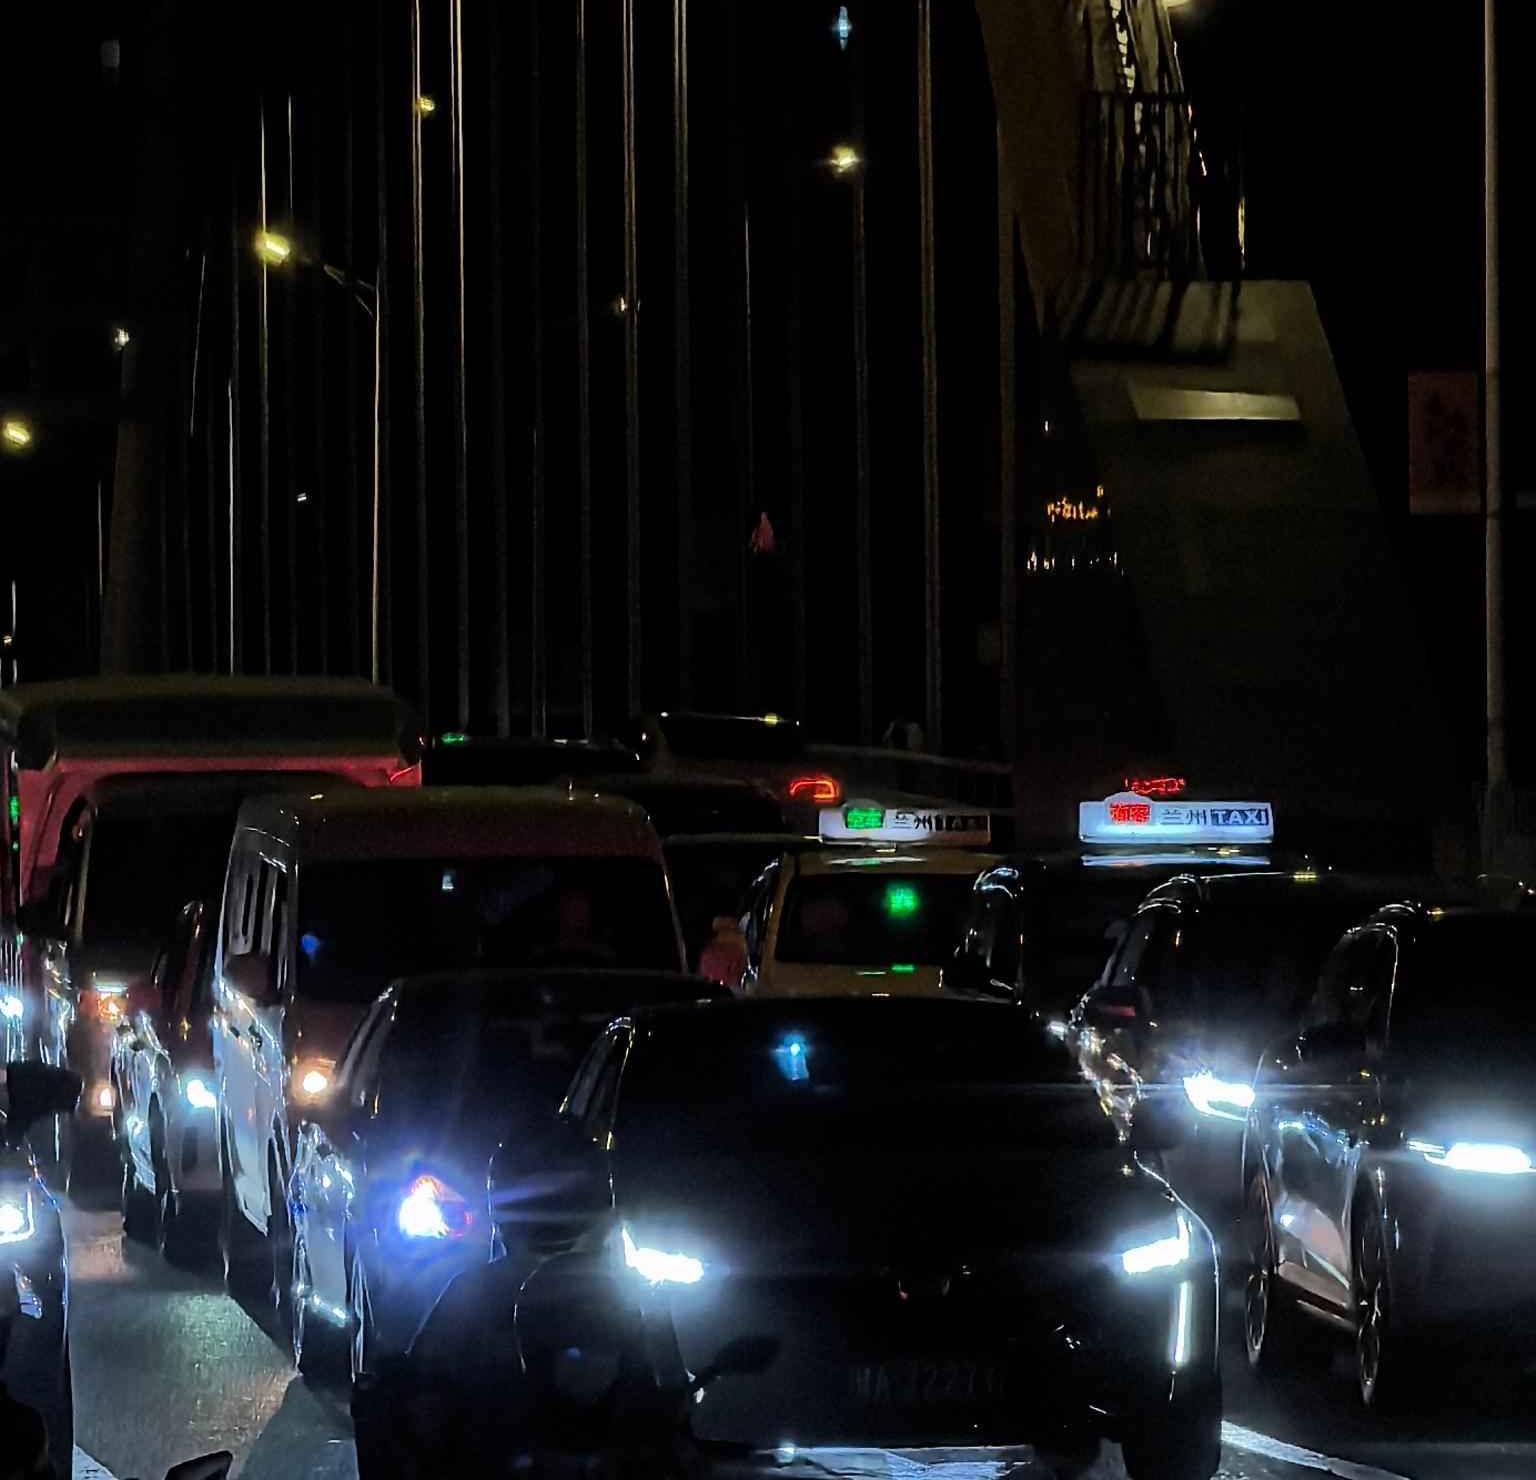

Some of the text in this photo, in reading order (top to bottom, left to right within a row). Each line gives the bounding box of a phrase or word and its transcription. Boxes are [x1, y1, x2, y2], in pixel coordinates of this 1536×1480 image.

[1109, 803, 1268, 826] 有客 兰州 TAXI
